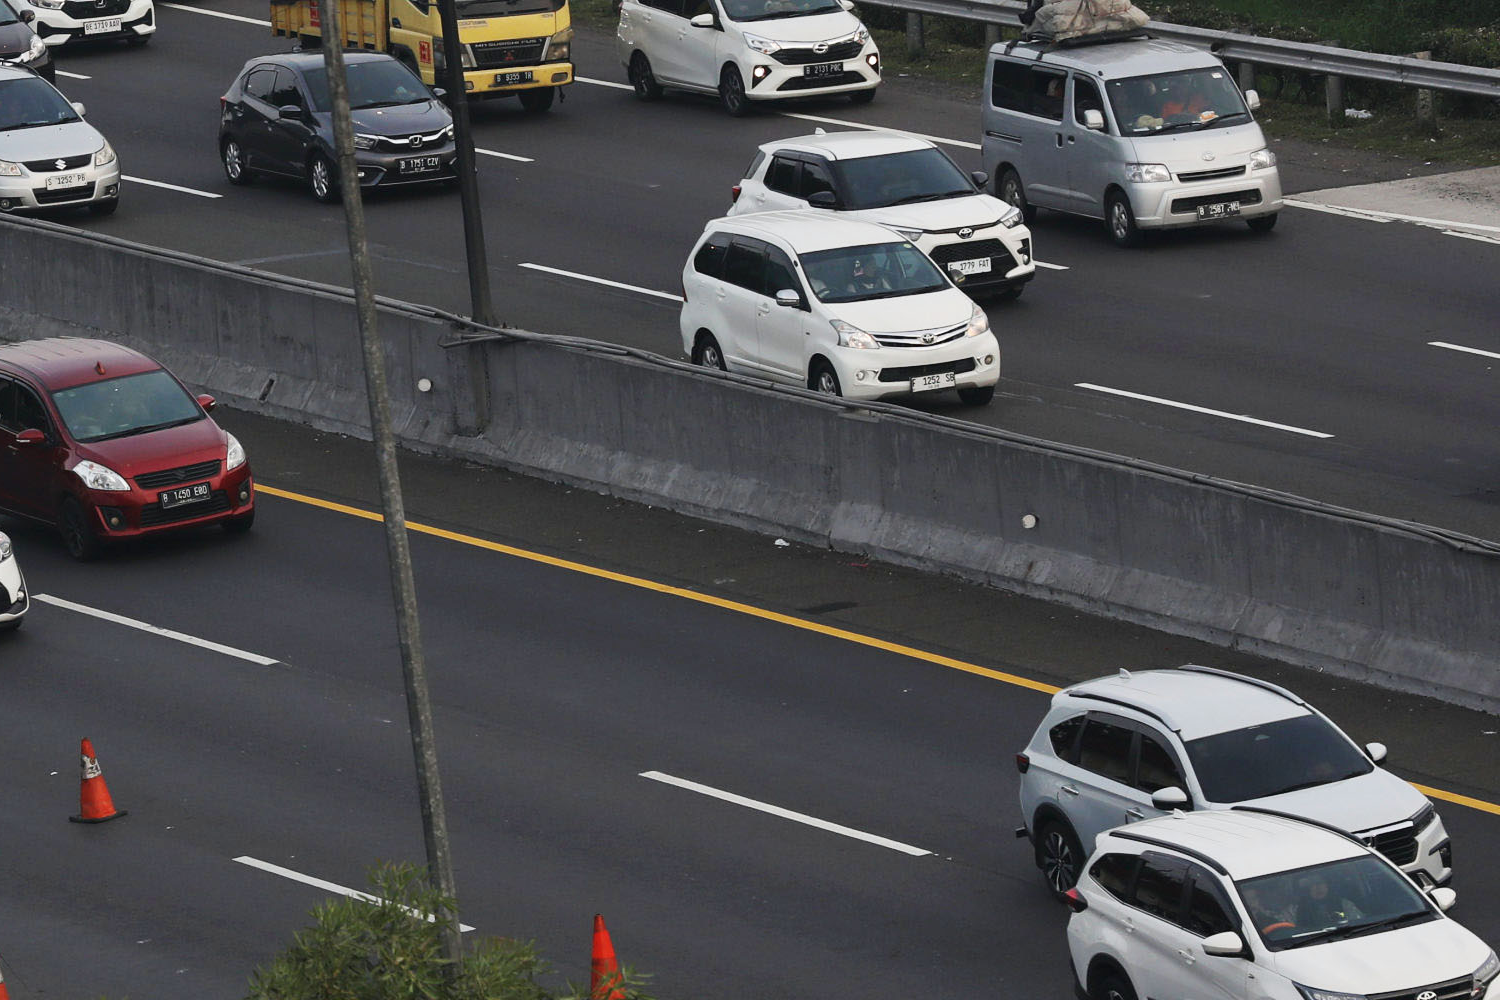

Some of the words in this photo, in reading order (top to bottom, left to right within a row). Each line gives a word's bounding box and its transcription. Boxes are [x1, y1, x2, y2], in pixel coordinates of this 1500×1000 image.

[85, 23, 92, 31] BE
[427, 157, 439, 166] CZV
[57, 176, 73, 185] 1252
[1199, 207, 1205, 216] B
[960, 261, 975, 270] 1779
[978, 259, 989, 268] FAT
[923, 375, 940, 385] 1252
[163, 493, 168, 503] B
[173, 488, 190, 499] 1450
